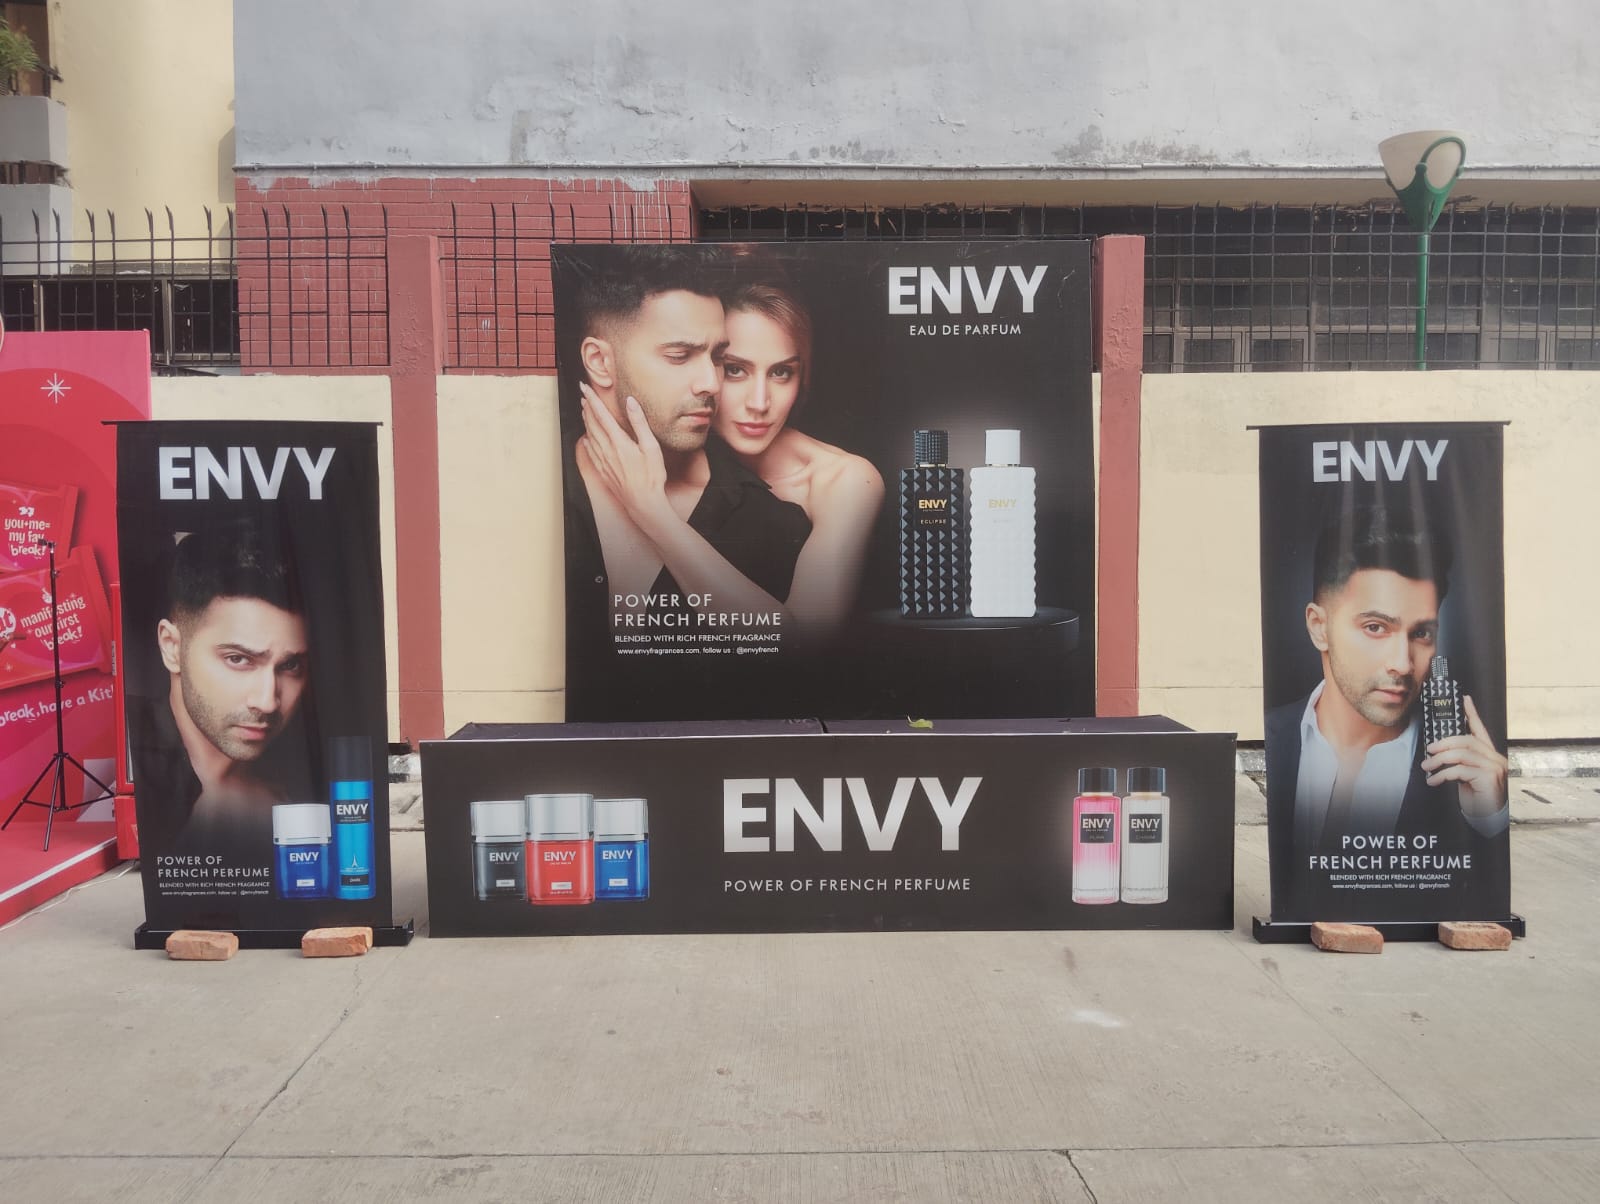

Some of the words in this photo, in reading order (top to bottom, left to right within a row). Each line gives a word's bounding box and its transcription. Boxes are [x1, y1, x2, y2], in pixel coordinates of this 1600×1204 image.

[889, 265, 1048, 314] ENVY
[909, 325, 937, 336] EAU
[942, 324, 960, 335] DE
[965, 323, 1022, 335] PARFUM
[1312, 439, 1449, 483] ENVY
[159, 446, 337, 500] ENVY
[918, 499, 948, 509] ENVY
[988, 499, 1016, 508] ENVY
[8, 531, 25, 544] my
[10, 543, 47, 556] break!
[614, 594, 681, 608] POWER
[687, 593, 712, 607] OF
[614, 613, 690, 627] FRENCH
[697, 612, 782, 626] PERFUME
[614, 635, 651, 643] BLENDED
[698, 634, 731, 642] FRENCH
[732, 634, 782, 642] FRAGRANCE
[1434, 699, 1452, 707] ENVY
[336, 803, 369, 816] ENVY
[723, 776, 983, 853] ENVY
[1082, 818, 1112, 829] ENVY
[1131, 818, 1160, 829] ENVY
[1342, 835, 1407, 849] POWER
[1413, 834, 1438, 849] OF
[157, 855, 201, 866] POWER
[205, 855, 223, 865] OF
[289, 851, 320, 862] ENVY
[489, 852, 520, 862] ENVY
[543, 850, 577, 862] ENVY
[602, 849, 634, 860] ENVY
[1309, 855, 1383, 870] FRENCH
[1389, 854, 1473, 869] PERFUME
[158, 868, 209, 878] FRENCH
[213, 867, 270, 877] PERFUME
[1390, 873, 1415, 881] FRENCH
[1415, 873, 1452, 881] FRAGRANCE
[724, 879, 784, 892] POWER
[790, 879, 813, 892] OF
[819, 878, 887, 891] FRENCH
[894, 878, 971, 891] PERFUME
